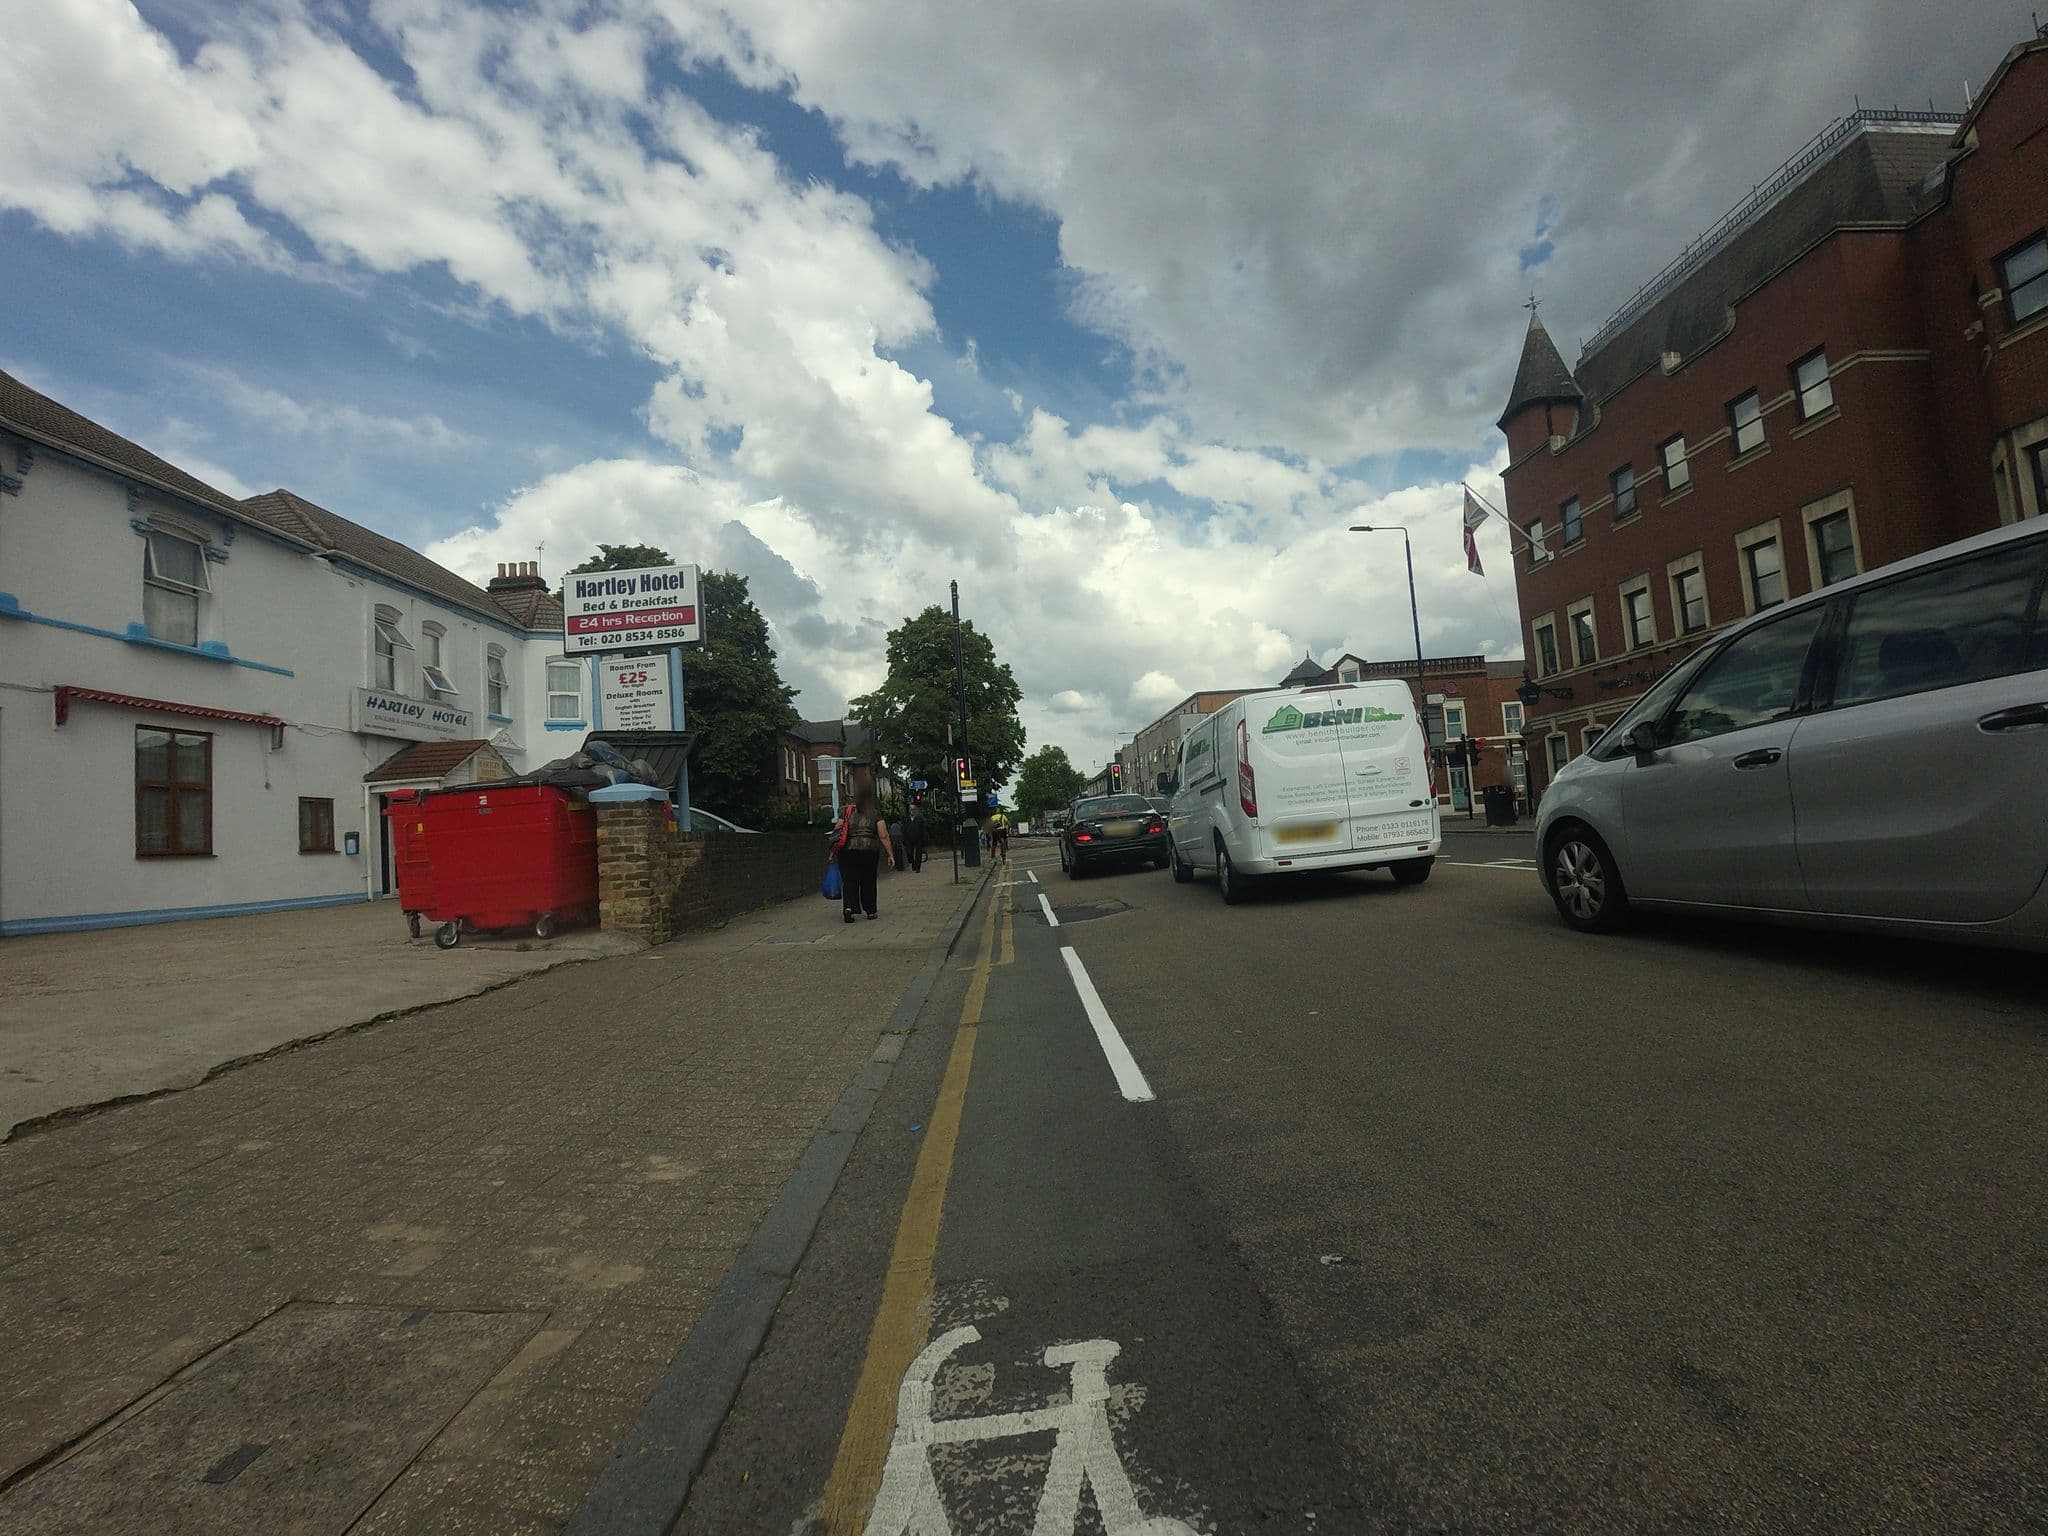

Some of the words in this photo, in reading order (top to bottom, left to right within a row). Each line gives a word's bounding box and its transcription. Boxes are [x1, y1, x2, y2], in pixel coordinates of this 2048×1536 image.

[576, 577, 636, 598] Hartley
[640, 571, 684, 592] Hotel
[583, 602, 605, 612] Bed
[609, 600, 618, 609] &
[622, 595, 678, 609] Breakfast
[579, 617, 598, 628] 24
[602, 616, 622, 626] hrs
[625, 611, 683, 624] Reception
[578, 636, 597, 646] Tel:
[601, 633, 622, 644] 020
[625, 630, 654, 642] 8534
[657, 628, 685, 639] 8586
[609, 664, 634, 672] Rooms
[619, 671, 648, 684] £25
[606, 692, 634, 700] Deluxe
[636, 689, 663, 697] Rooms
[366, 696, 425, 719] HARTLEY
[432, 710, 468, 727] HOTEL
[1303, 707, 1363, 728] BENI
